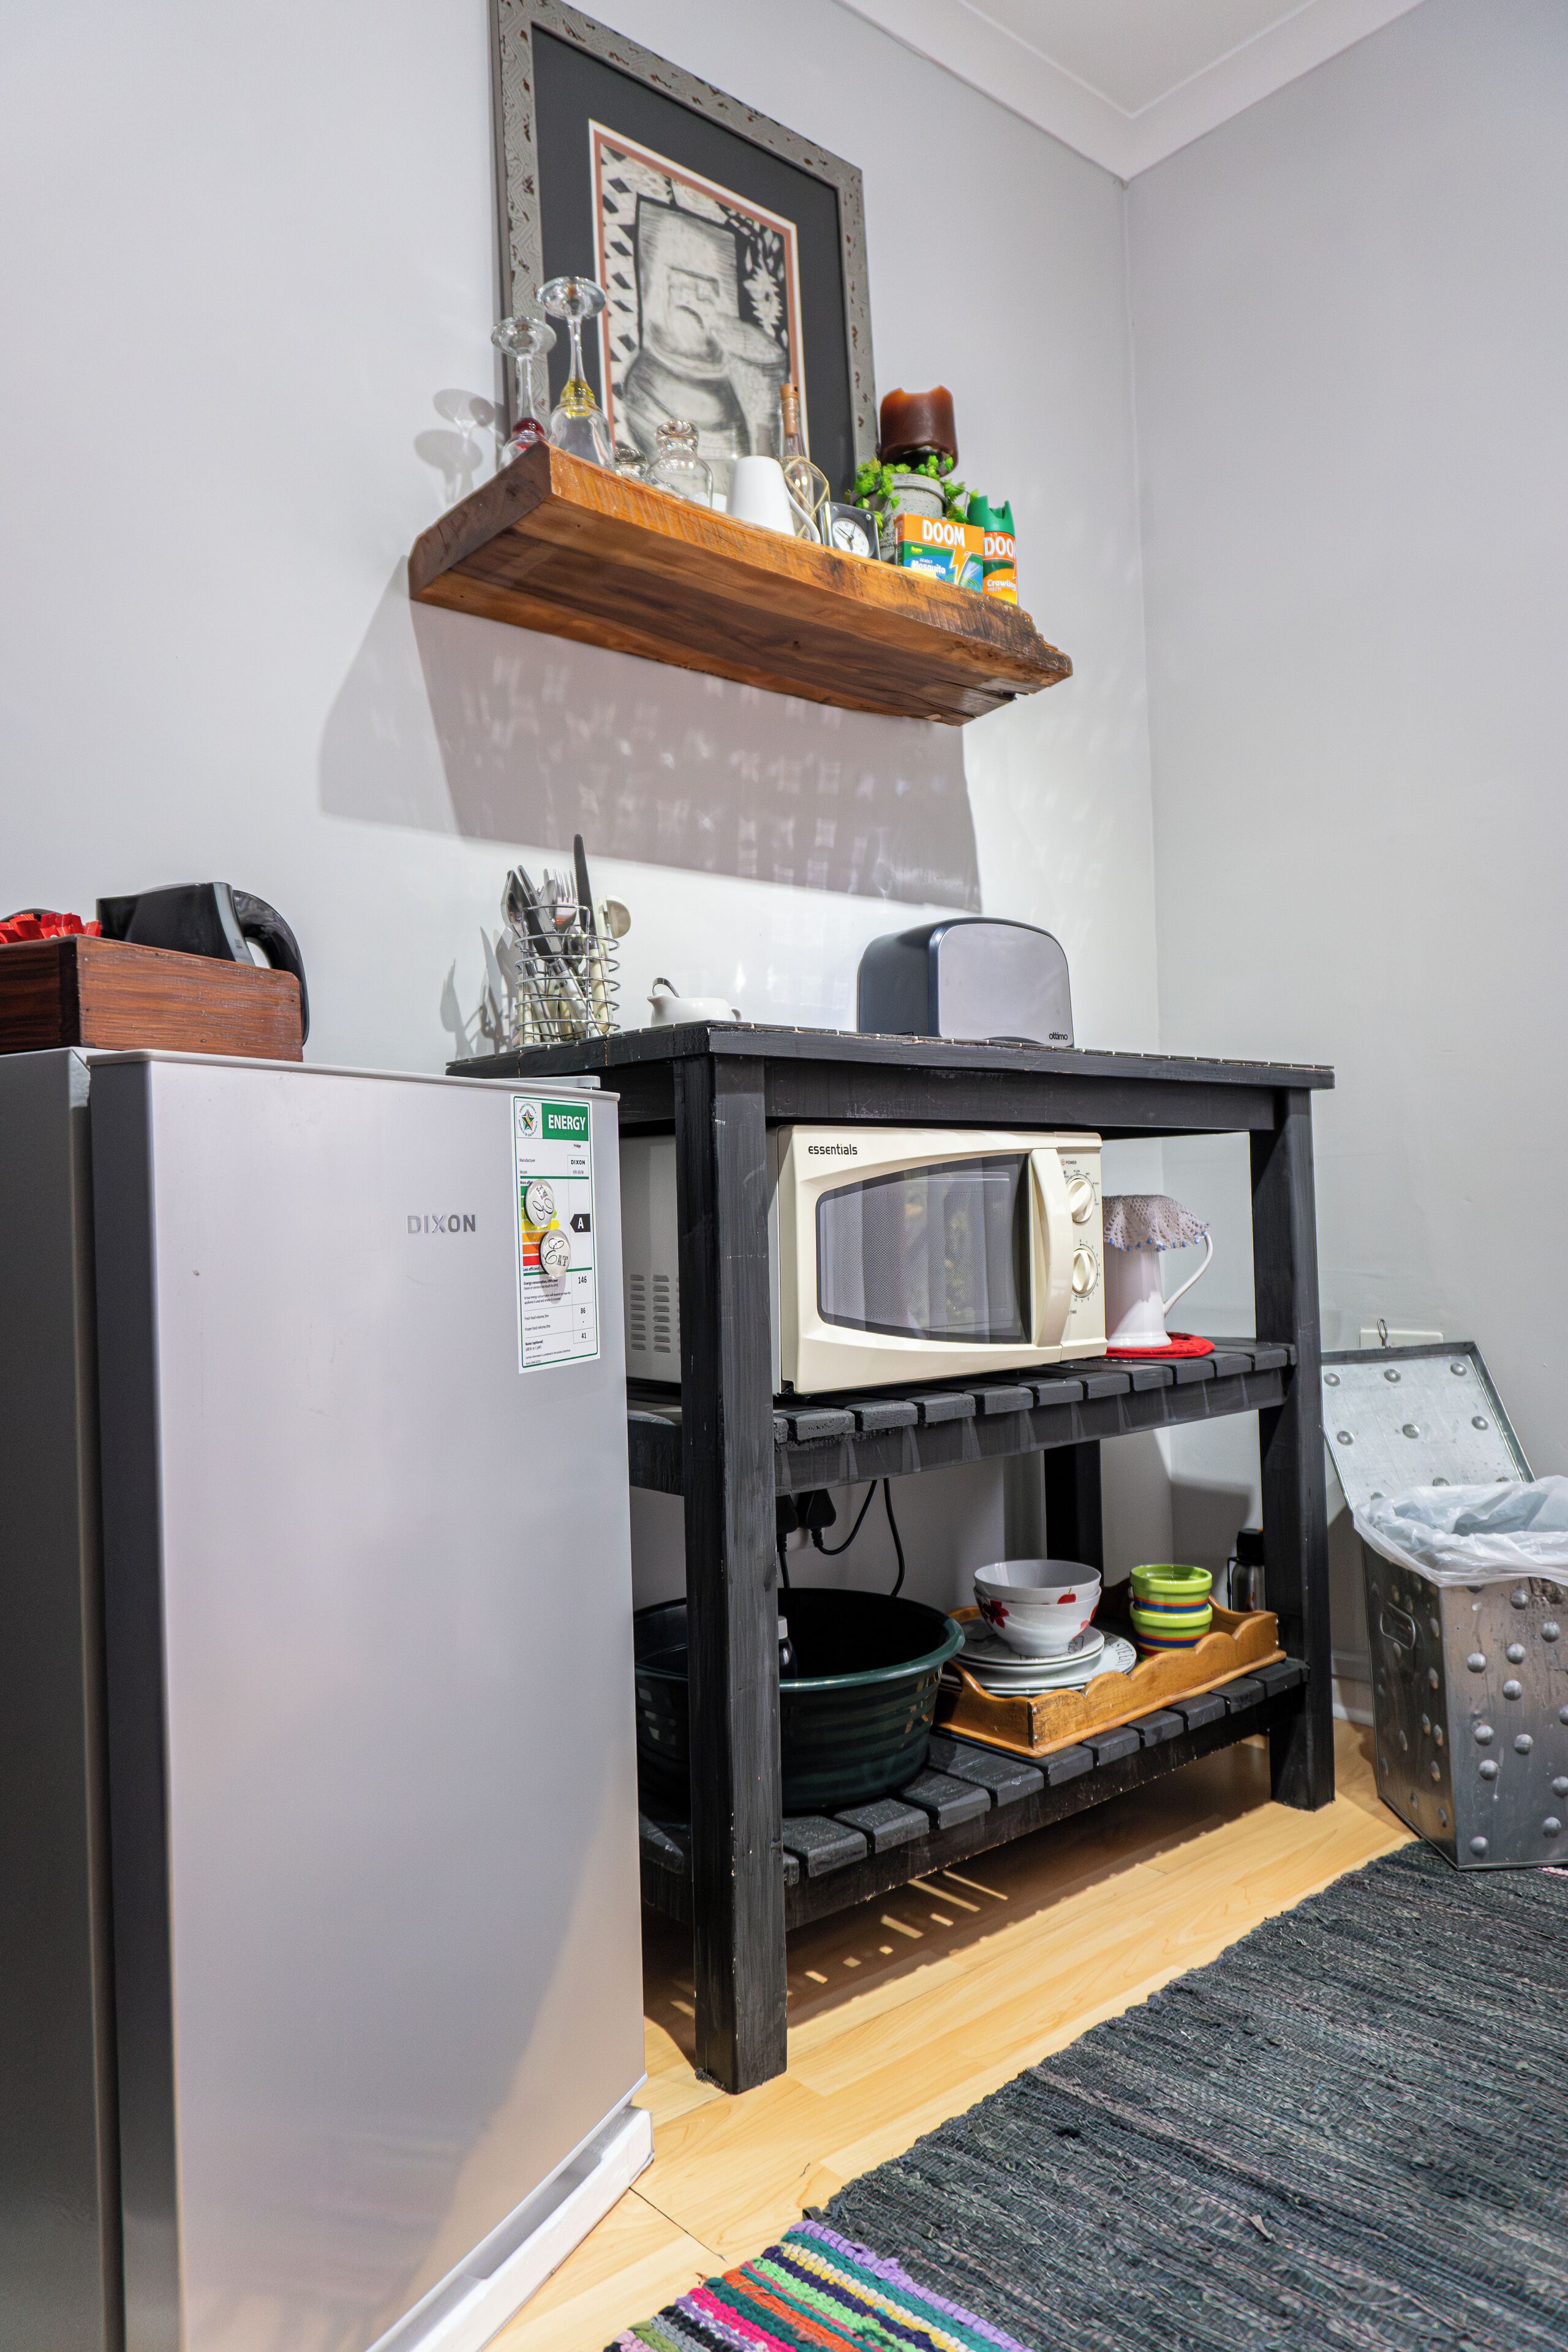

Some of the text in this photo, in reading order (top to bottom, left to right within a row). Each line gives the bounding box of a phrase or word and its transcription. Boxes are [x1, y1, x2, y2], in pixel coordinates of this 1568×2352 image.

[922, 519, 965, 548] DOOM
[910, 559, 947, 575] Mosquito
[987, 579, 1016, 592] Crawling
[1049, 1031, 1068, 1040] ottimo
[548, 1114, 586, 1131] ENERGY
[808, 1143, 858, 1155] essentials
[407, 1214, 476, 1234] DIXON
[578, 1217, 584, 1229] A
